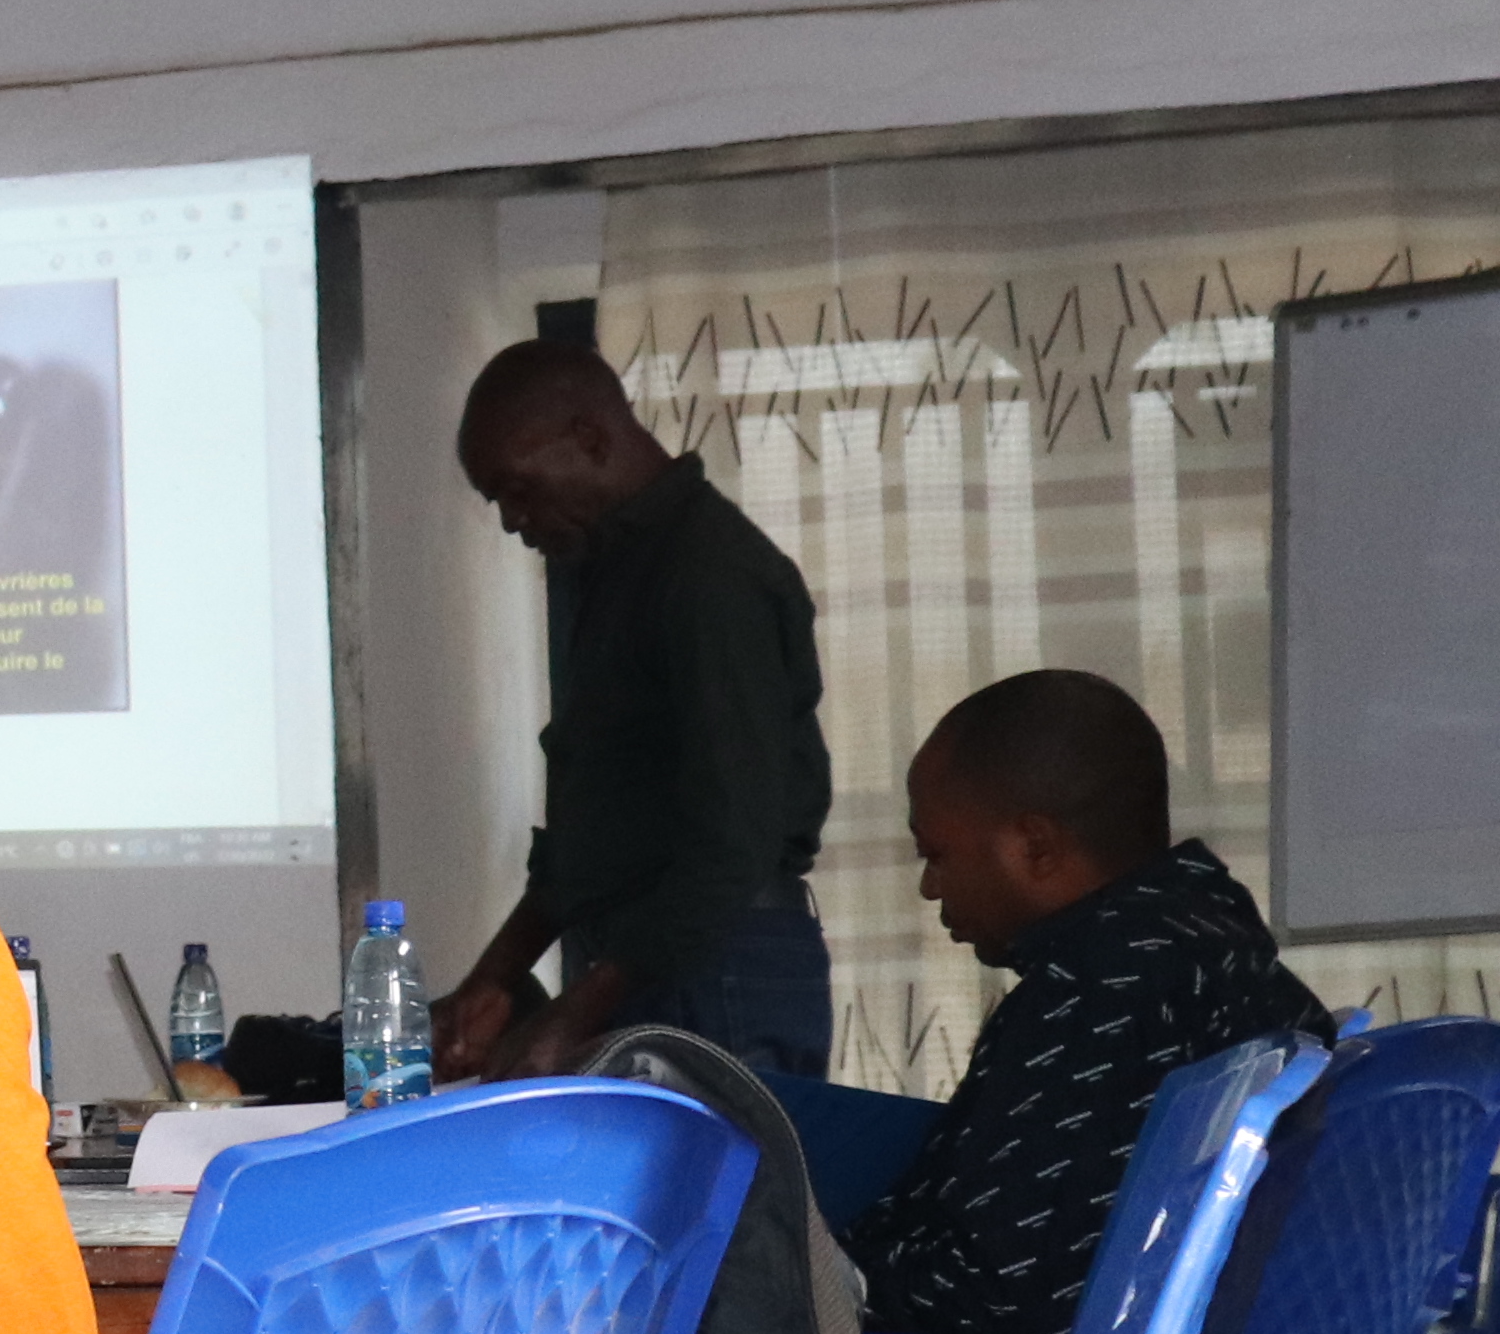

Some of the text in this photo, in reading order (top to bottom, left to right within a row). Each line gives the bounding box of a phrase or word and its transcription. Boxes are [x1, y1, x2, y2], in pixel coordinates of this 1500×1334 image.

[51, 598, 77, 615] de
[85, 597, 104, 614] la
[44, 652, 63, 670] le
